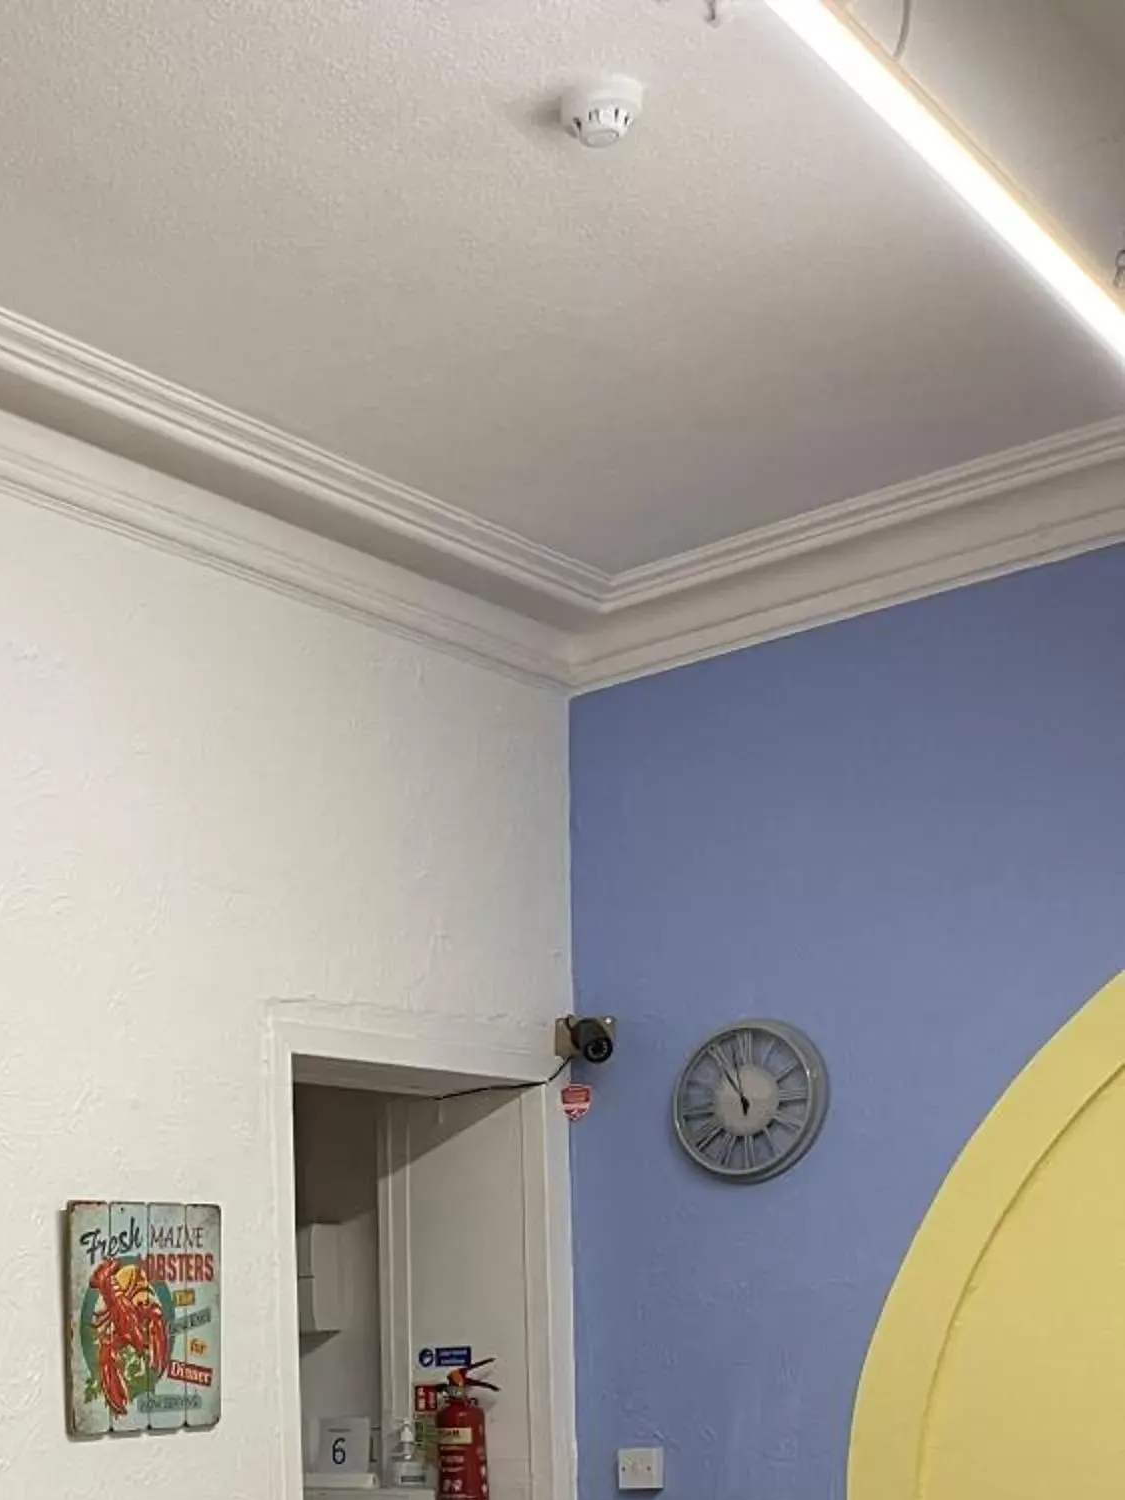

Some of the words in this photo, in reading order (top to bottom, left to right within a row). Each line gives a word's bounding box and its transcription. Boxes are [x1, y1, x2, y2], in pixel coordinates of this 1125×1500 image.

[80, 1215, 143, 1266] Fresh
[151, 1223, 205, 1250] MAINE
[331, 1437, 347, 1465] 6
